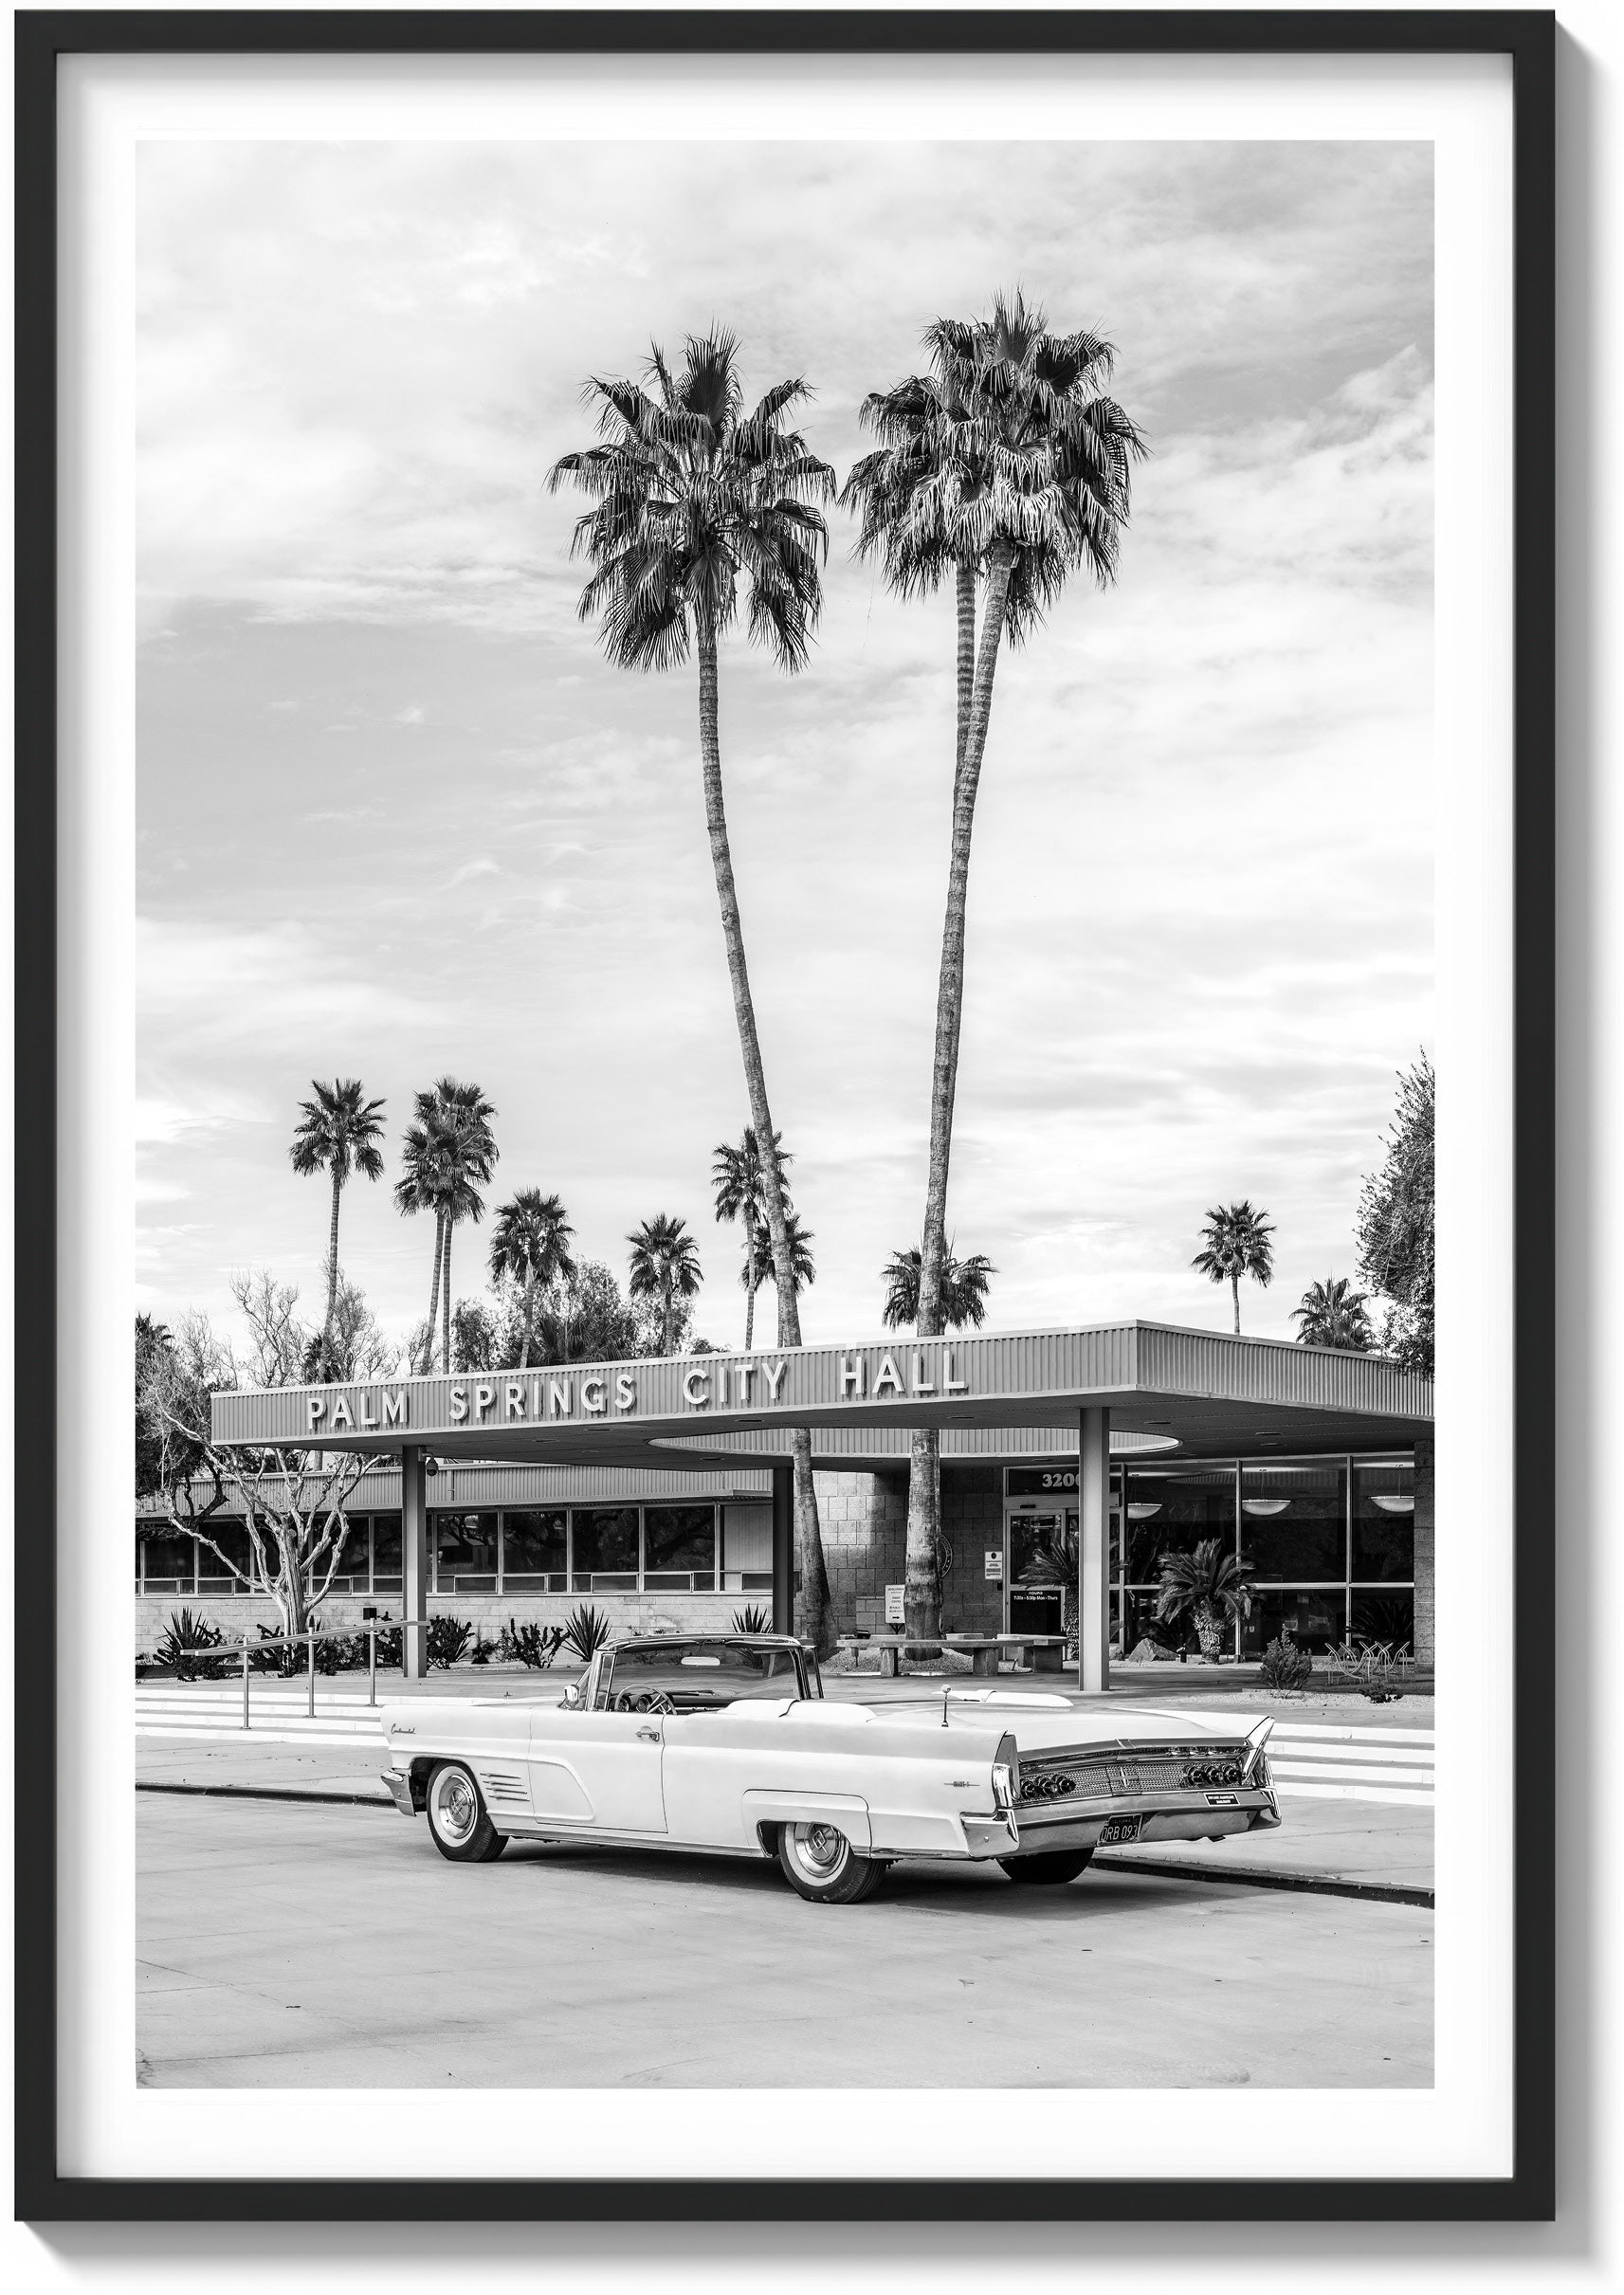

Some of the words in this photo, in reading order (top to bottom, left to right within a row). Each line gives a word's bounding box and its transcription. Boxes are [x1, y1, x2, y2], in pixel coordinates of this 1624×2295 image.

[307, 1391, 407, 1429] PALM
[448, 1375, 636, 1420] SPRINGS
[683, 1361, 786, 1405] CITY
[841, 1350, 968, 1394] HALL
[1122, 1825, 1139, 1839] 093
